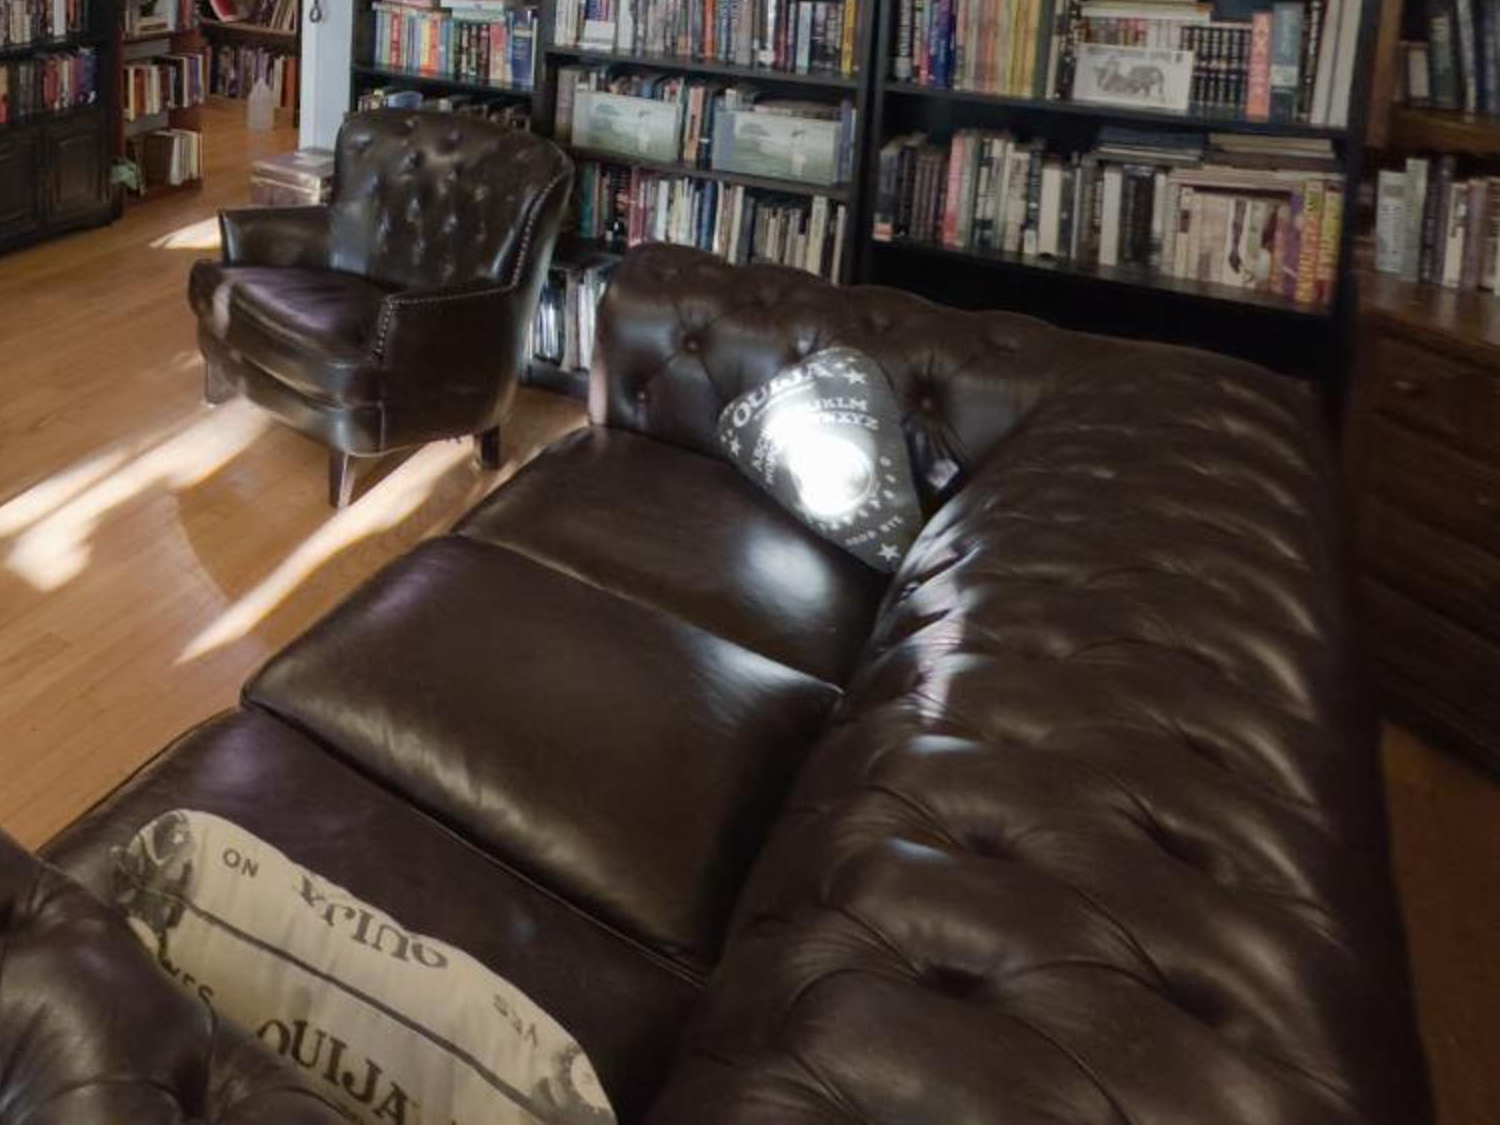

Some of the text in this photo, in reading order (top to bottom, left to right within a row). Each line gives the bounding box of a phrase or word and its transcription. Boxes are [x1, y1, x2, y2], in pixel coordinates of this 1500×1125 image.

[223, 848, 259, 878] NO
[299, 876, 448, 968] OUIJA
[257, 1019, 410, 1125] OUIJA
